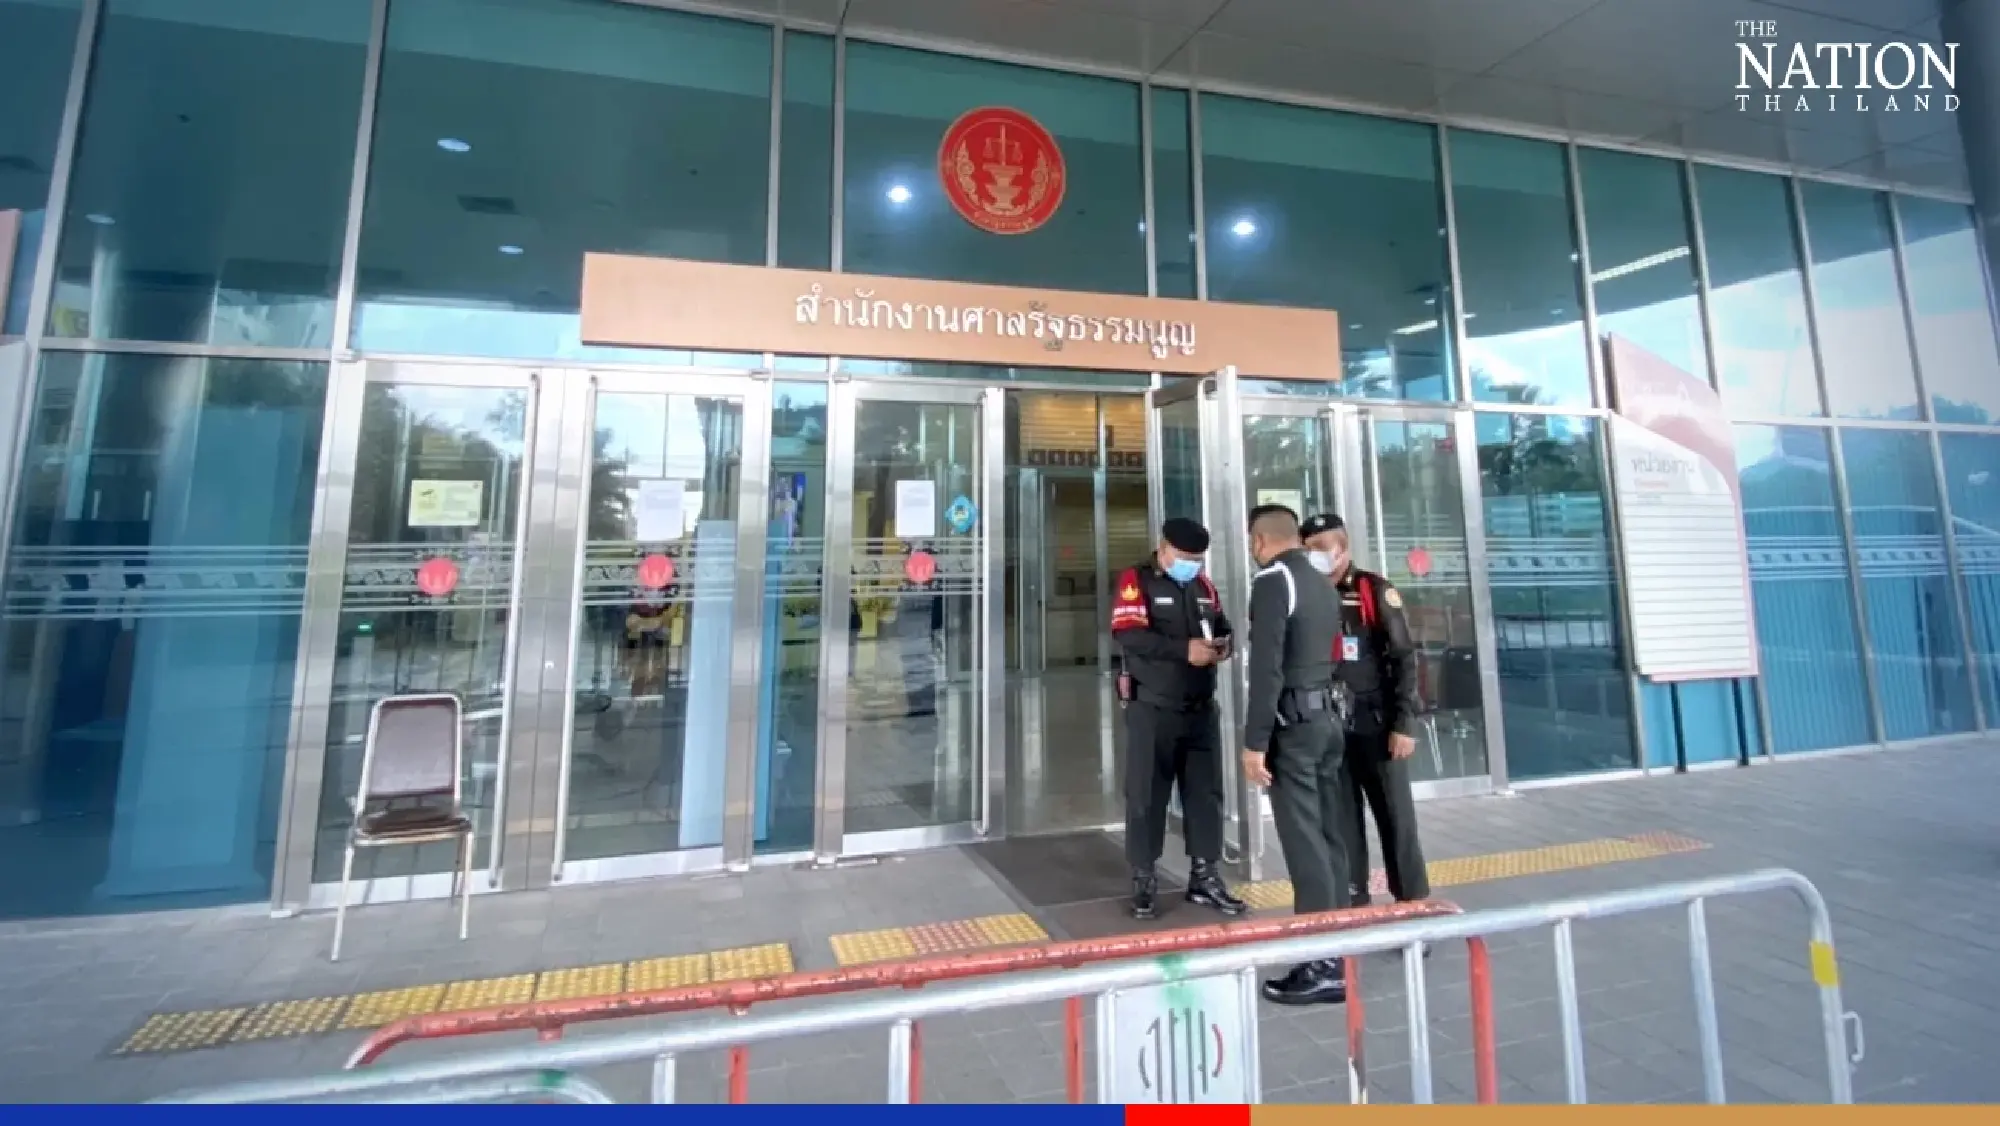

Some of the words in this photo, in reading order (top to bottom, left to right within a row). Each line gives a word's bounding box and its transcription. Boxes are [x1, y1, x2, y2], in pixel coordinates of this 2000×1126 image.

[794, 282, 1197, 360] สำนักงานศาลรัฐธรรมนูญ
